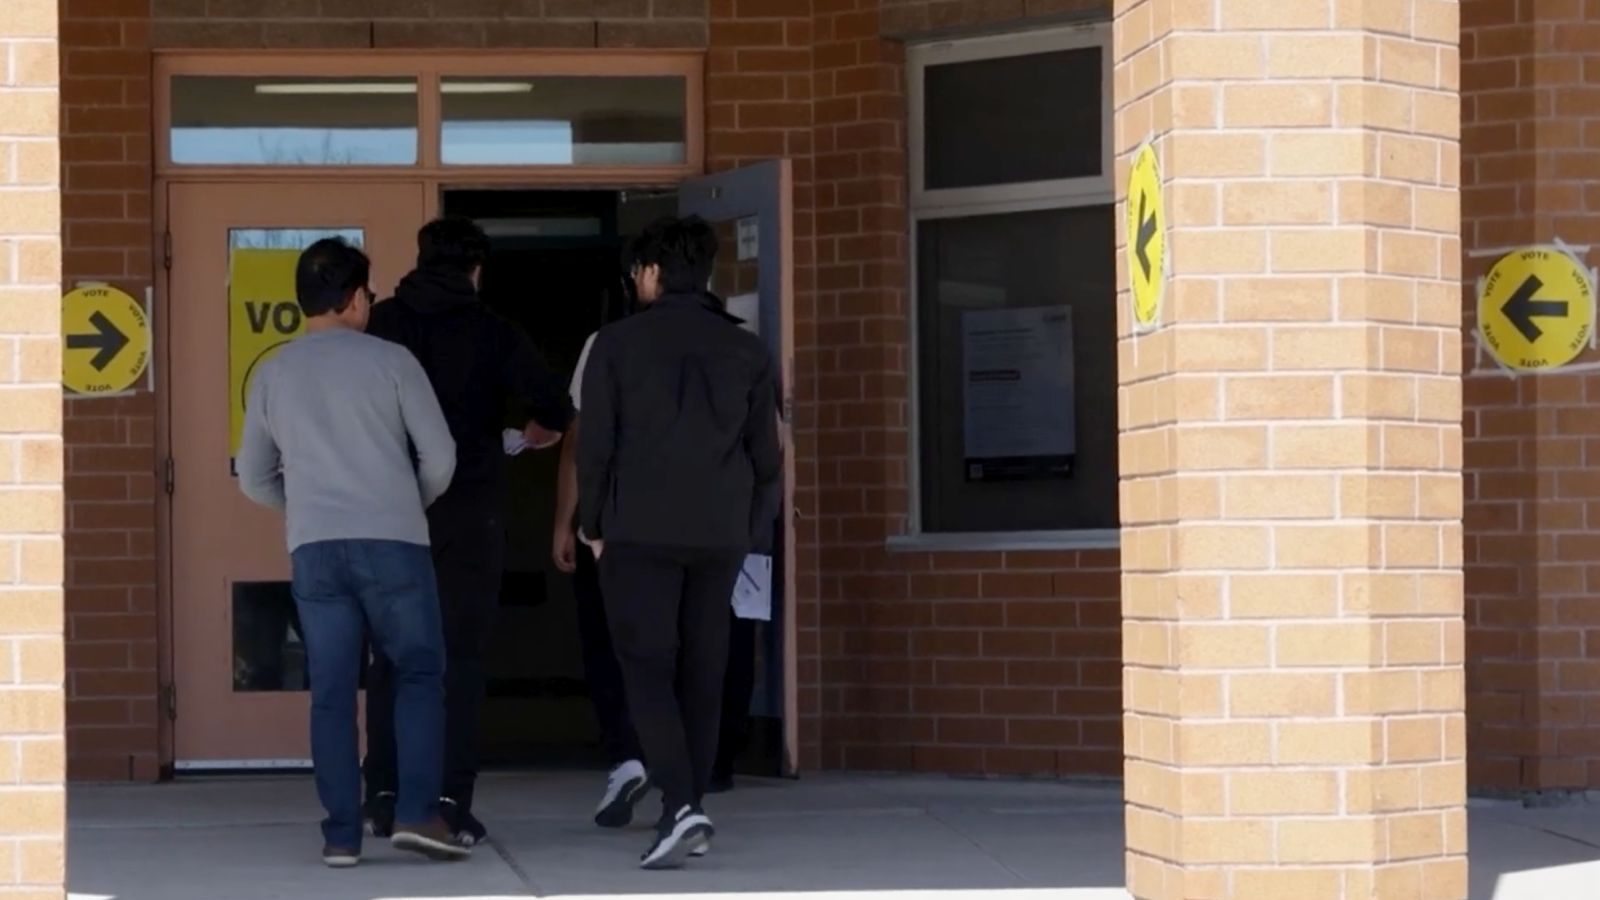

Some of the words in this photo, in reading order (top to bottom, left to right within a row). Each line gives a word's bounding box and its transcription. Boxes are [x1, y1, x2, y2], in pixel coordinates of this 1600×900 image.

[1521, 251, 1549, 260] VOTE
[1572, 269, 1589, 296] VOTE
[82, 289, 109, 297] VOTE
[244, 301, 303, 335] VO
